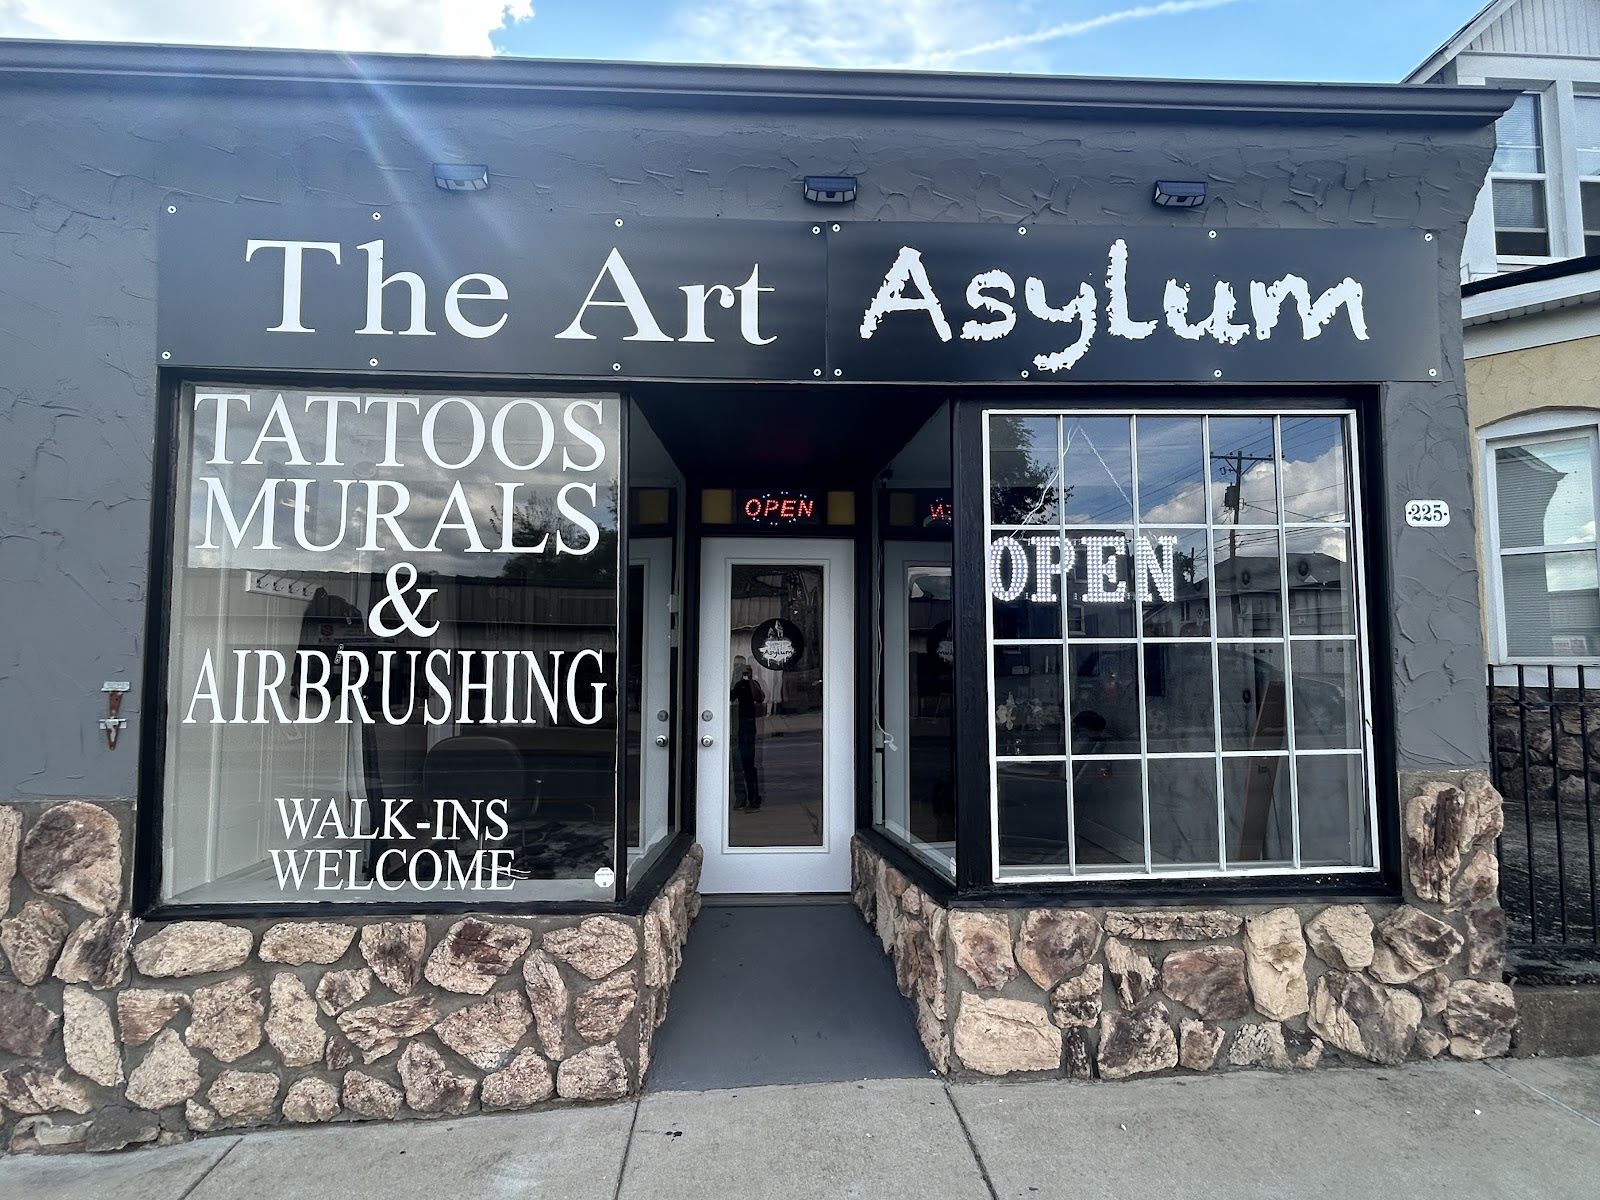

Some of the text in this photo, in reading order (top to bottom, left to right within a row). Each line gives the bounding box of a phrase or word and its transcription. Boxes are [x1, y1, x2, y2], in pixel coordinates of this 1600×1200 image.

[245, 239, 1370, 373] The Art Asylum
[193, 393, 607, 472] TATTOOS
[195, 477, 600, 555] MURALS
[745, 499, 813, 517] OPEN
[1411, 504, 1443, 521] 225
[368, 562, 441, 638] &
[990, 536, 1178, 603] OPEN
[182, 648, 608, 726] AIRBRUSHING
[274, 797, 509, 841] WALK-INS
[268, 849, 516, 891] WELCOME
